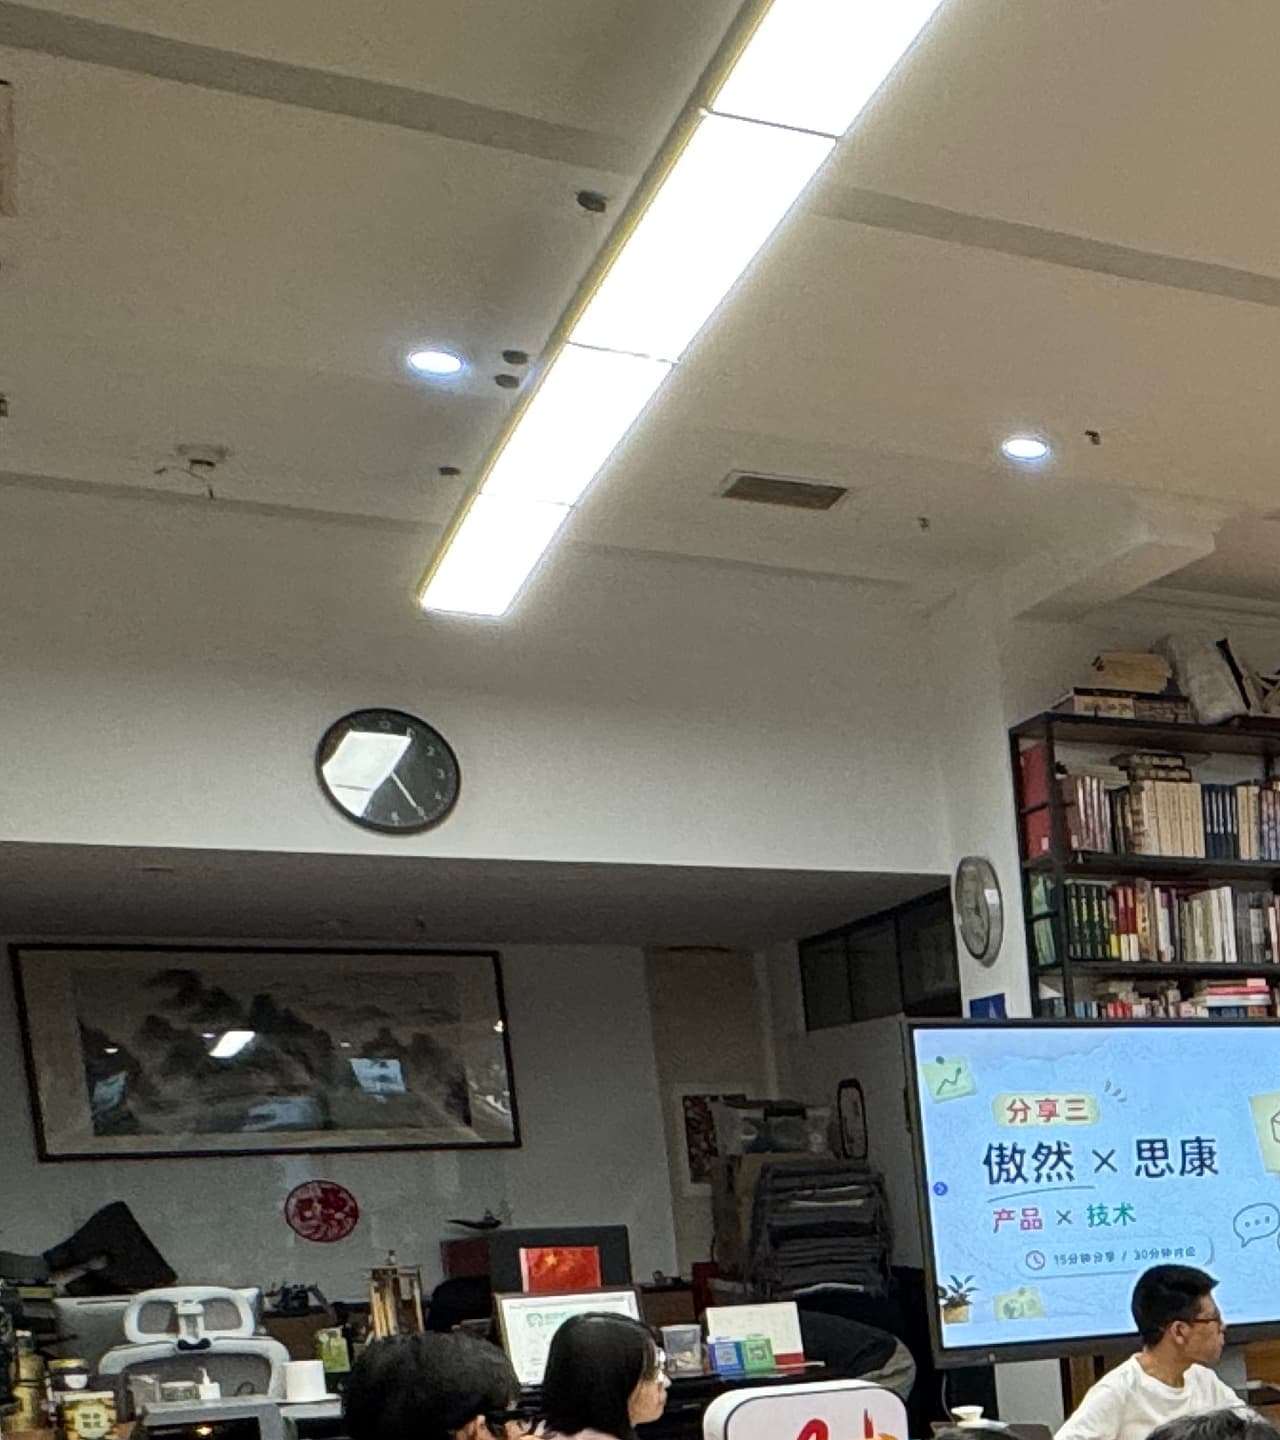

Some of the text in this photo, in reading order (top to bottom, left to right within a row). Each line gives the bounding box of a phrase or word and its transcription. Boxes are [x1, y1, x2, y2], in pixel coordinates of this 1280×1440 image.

[1005, 1096, 1089, 1122] 分享三
[982, 1140, 1076, 1186] 傲然
[1135, 1136, 1220, 1179] 思康
[992, 1207, 1043, 1233] 产品
[1086, 1203, 1137, 1228] 技术
